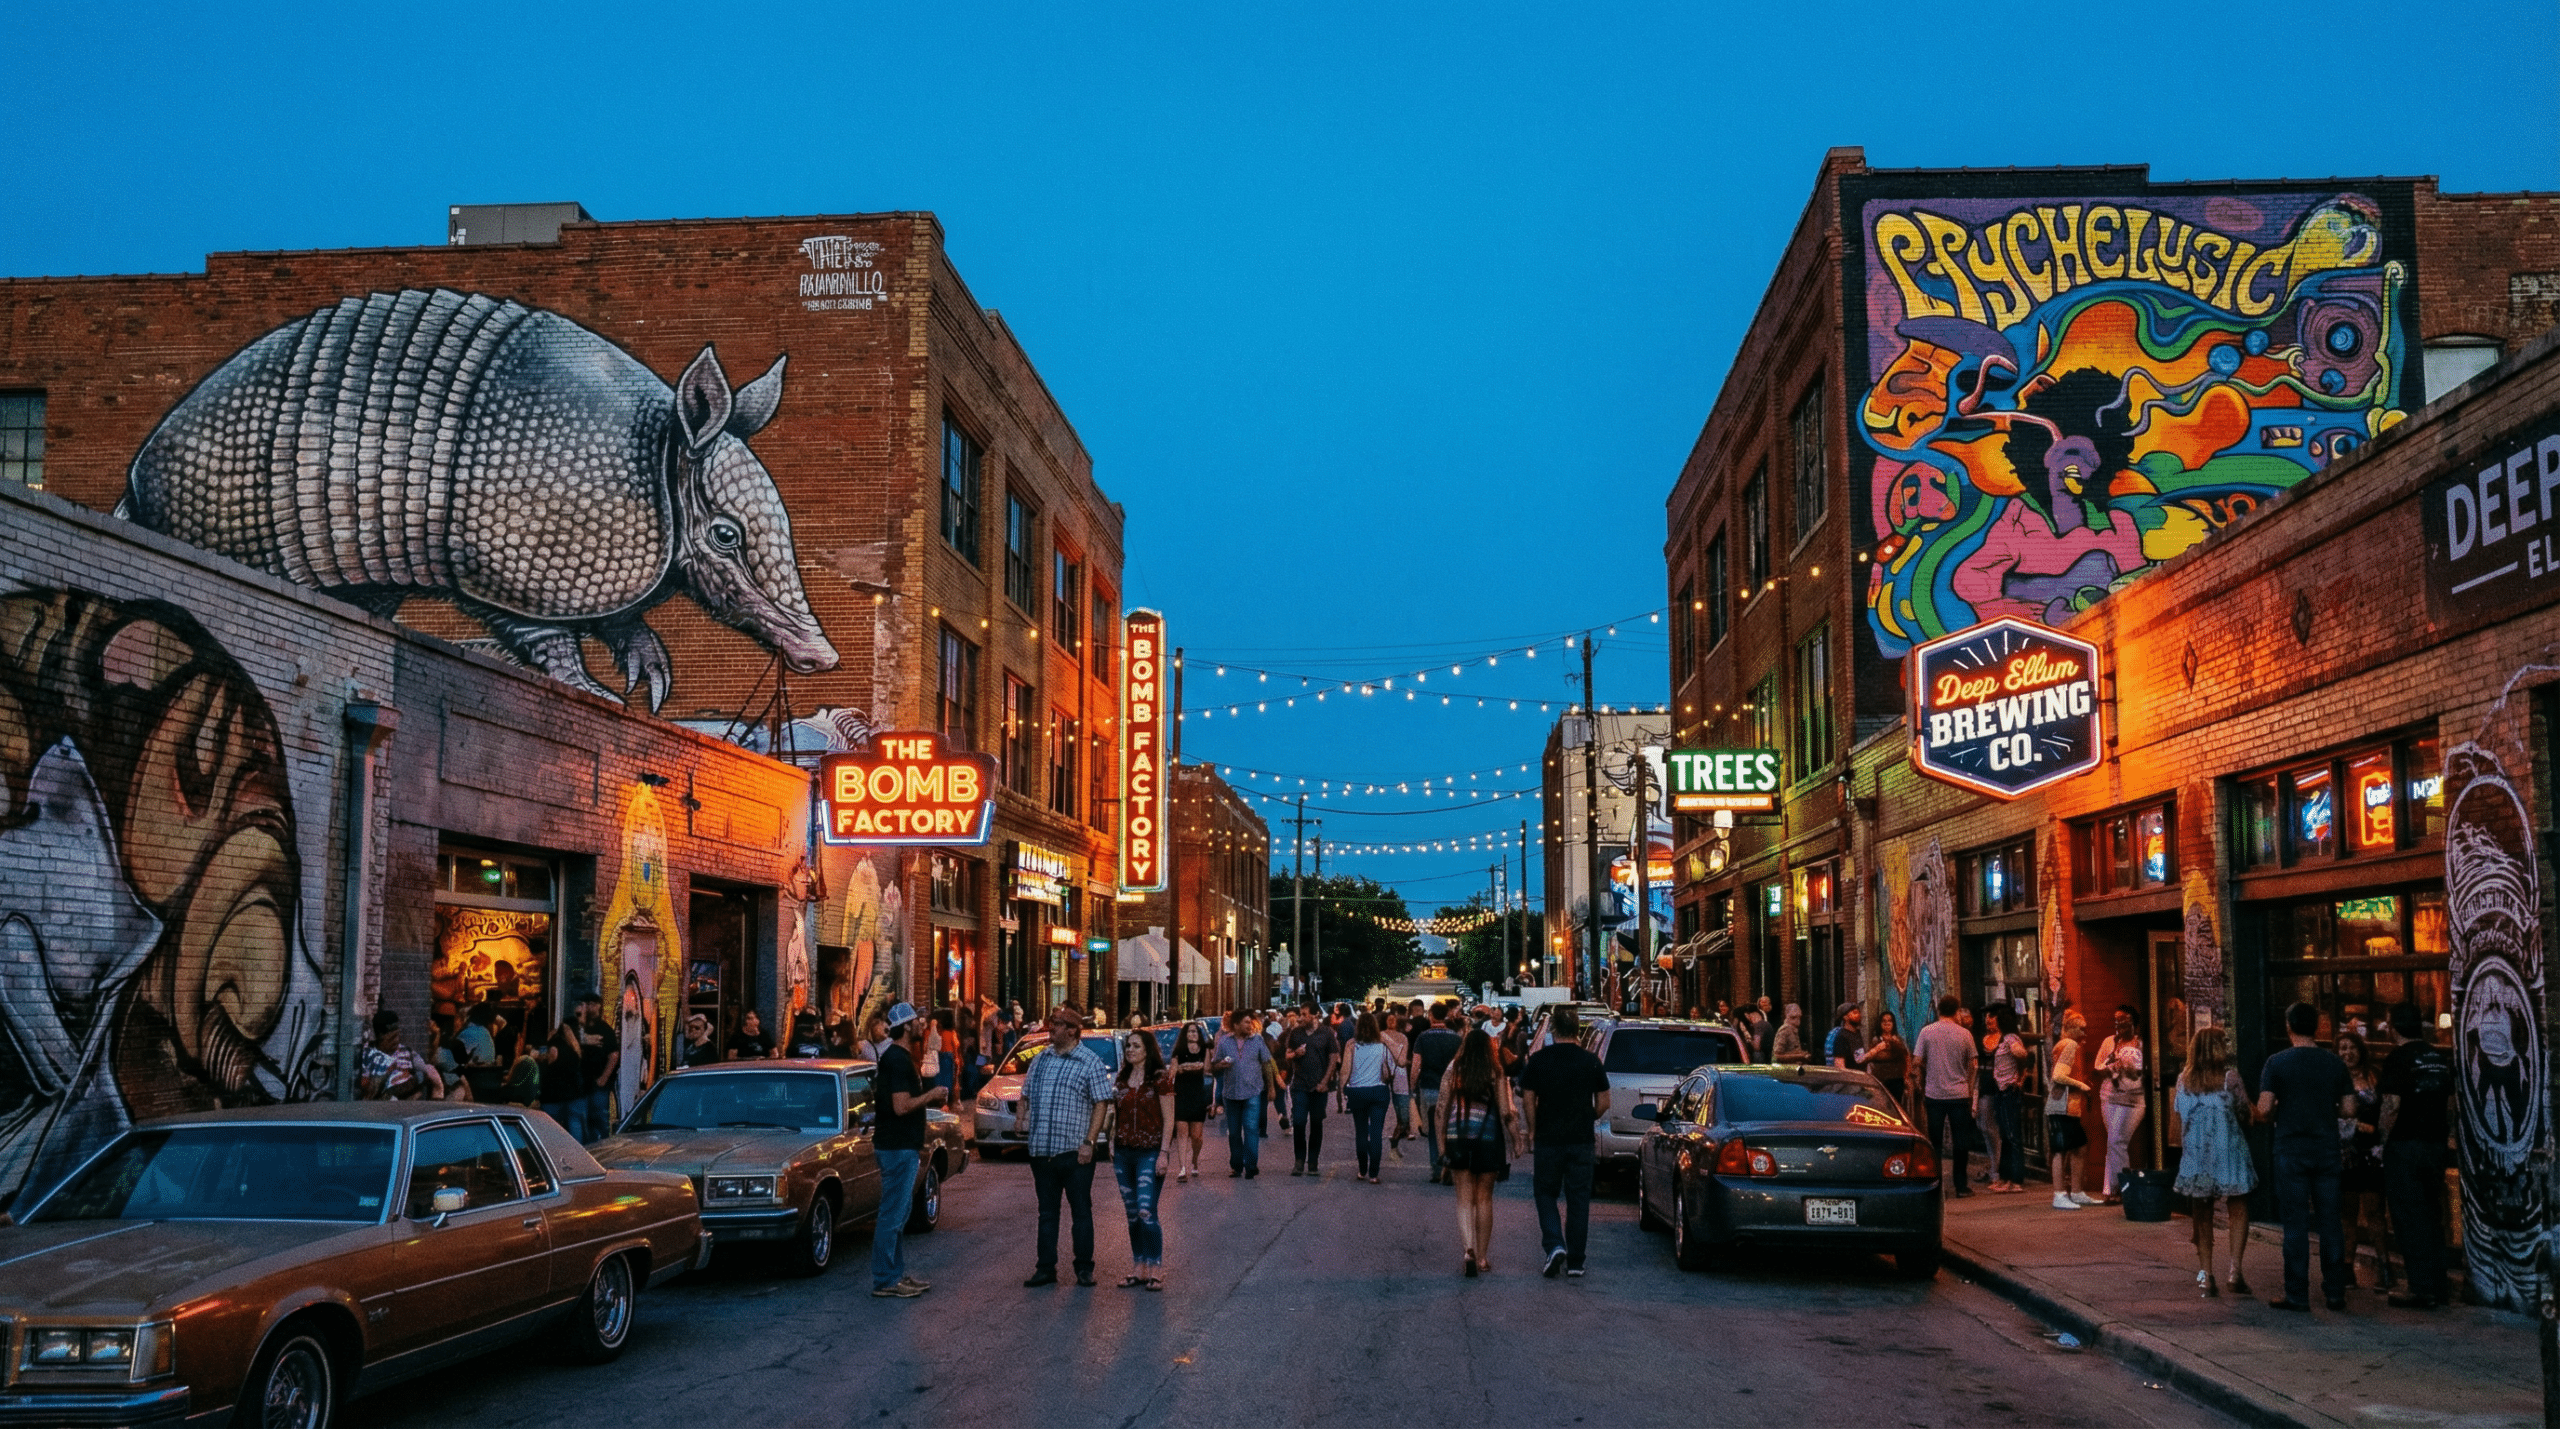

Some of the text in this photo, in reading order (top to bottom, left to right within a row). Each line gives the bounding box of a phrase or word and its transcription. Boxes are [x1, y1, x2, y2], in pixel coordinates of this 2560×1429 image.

[2446, 434, 2560, 562] DEEP
[1130, 623, 1156, 633] THE
[1132, 639, 1154, 723] BOMB
[1936, 652, 2079, 706] Deep Ellum
[1929, 681, 2091, 748] BREWING
[881, 739, 932, 760] THE
[1989, 733, 2043, 771] CO.
[834, 765, 979, 803] BOMB
[1670, 753, 1777, 791] TREES
[837, 809, 975, 833] FACTORY
[1131, 732, 1154, 881] FACTORY
